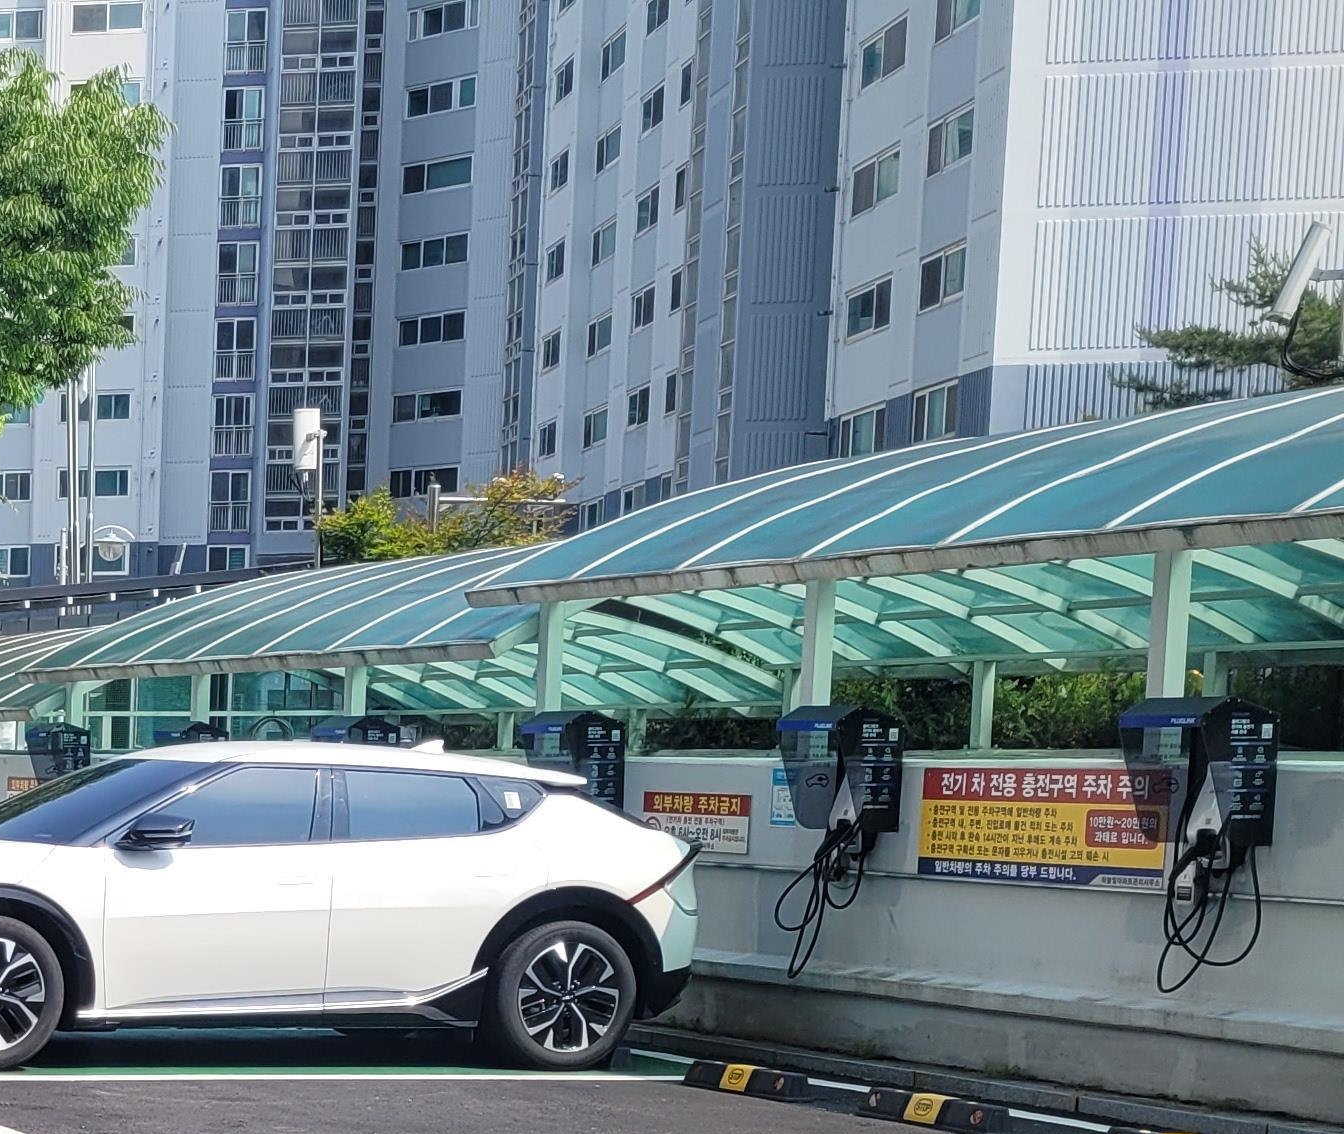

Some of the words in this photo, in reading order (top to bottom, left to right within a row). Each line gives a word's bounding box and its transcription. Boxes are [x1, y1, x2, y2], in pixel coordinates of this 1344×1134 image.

[941, 771, 968, 796] 전기
[971, 772, 986, 796] 차
[989, 773, 1018, 797] 전용
[1021, 773, 1078, 800] 충전구역
[1082, 775, 1113, 799] 주차
[1117, 775, 1150, 801] 주의
[652, 793, 694, 813] 외부차량
[697, 796, 741, 816] 주차금지
[1043, 807, 1058, 818] 주차
[1044, 820, 1058, 832] 또는
[1060, 822, 1074, 832] 주차
[710, 828, 722, 843] 8시
[1063, 836, 1078, 846] 주차
[1094, 831, 1118, 844] 과태료
[1121, 832, 1149, 845] 입니다.
[976, 845, 991, 856] 또는
[1012, 846, 1039, 858] 지우거나
[1101, 851, 1110, 862] 시
[934, 860, 973, 875] 일반차량의
[974, 862, 992, 876] 주차
[993, 862, 1018, 877] 주의를
[1020, 864, 1038, 879] 당부
[1039, 866, 1077, 881] 드립니다.
